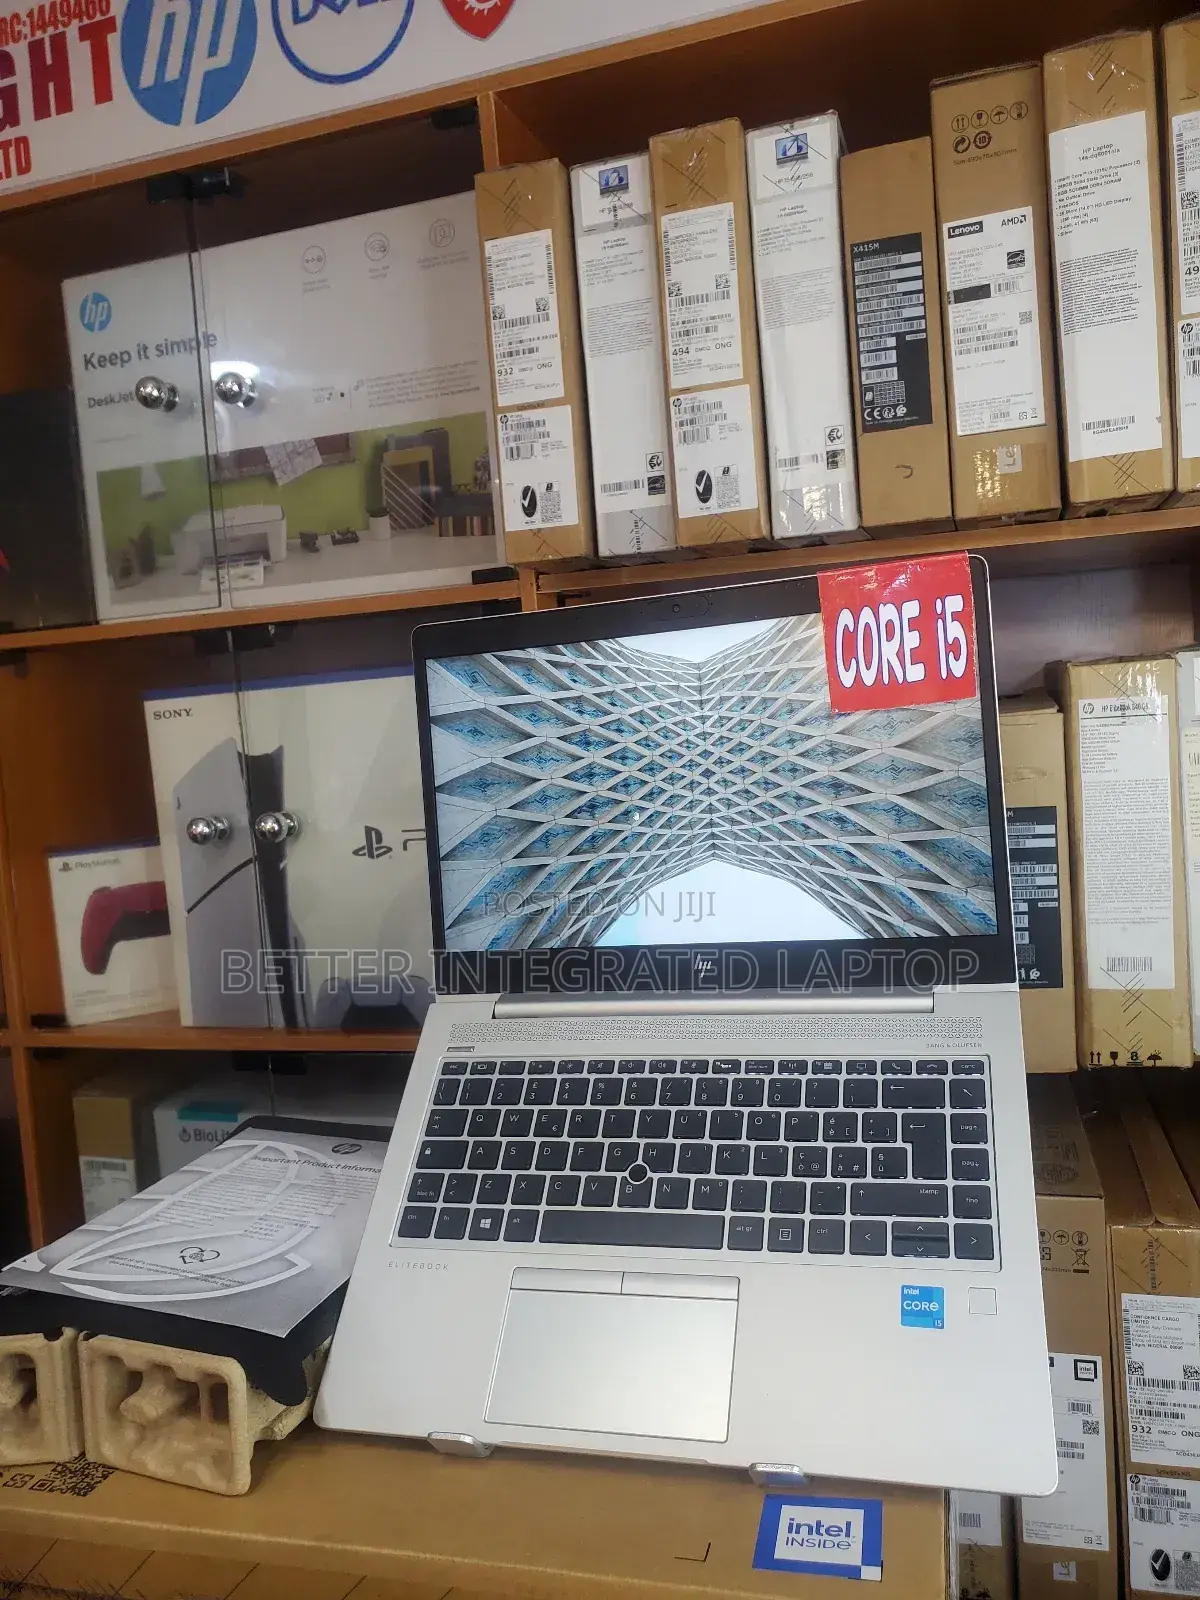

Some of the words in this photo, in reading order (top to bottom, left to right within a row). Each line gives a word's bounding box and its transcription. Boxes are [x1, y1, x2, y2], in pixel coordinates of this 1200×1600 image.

[1092, 143, 1114, 152] Laptop
[0, 136, 31, 179] TD
[950, 224, 980, 236] Lenovo
[1001, 216, 1019, 227] AMD
[854, 242, 880, 254] X415M
[1181, 322, 1193, 334] hp
[84, 350, 132, 370] Keep
[136, 343, 150, 361] it
[155, 331, 218, 358] simple
[672, 346, 690, 356] 494
[715, 341, 732, 350] ONG
[497, 367, 514, 377] 932
[536, 362, 552, 370] ONG
[836, 599, 926, 688] CORE
[934, 594, 968, 680] i5
[153, 708, 193, 720] SONY
[75, 857, 120, 870] PlayStation
[250, 1155, 301, 1164] Important
[302, 1160, 341, 1170] Product
[626, 1185, 632, 1193] B
[663, 1184, 670, 1192] N
[388, 1262, 449, 1271] ELITEBOOK
[934, 1318, 942, 1328] i5
[1132, 1425, 1152, 1434] 932
[787, 1518, 855, 1539] intel
